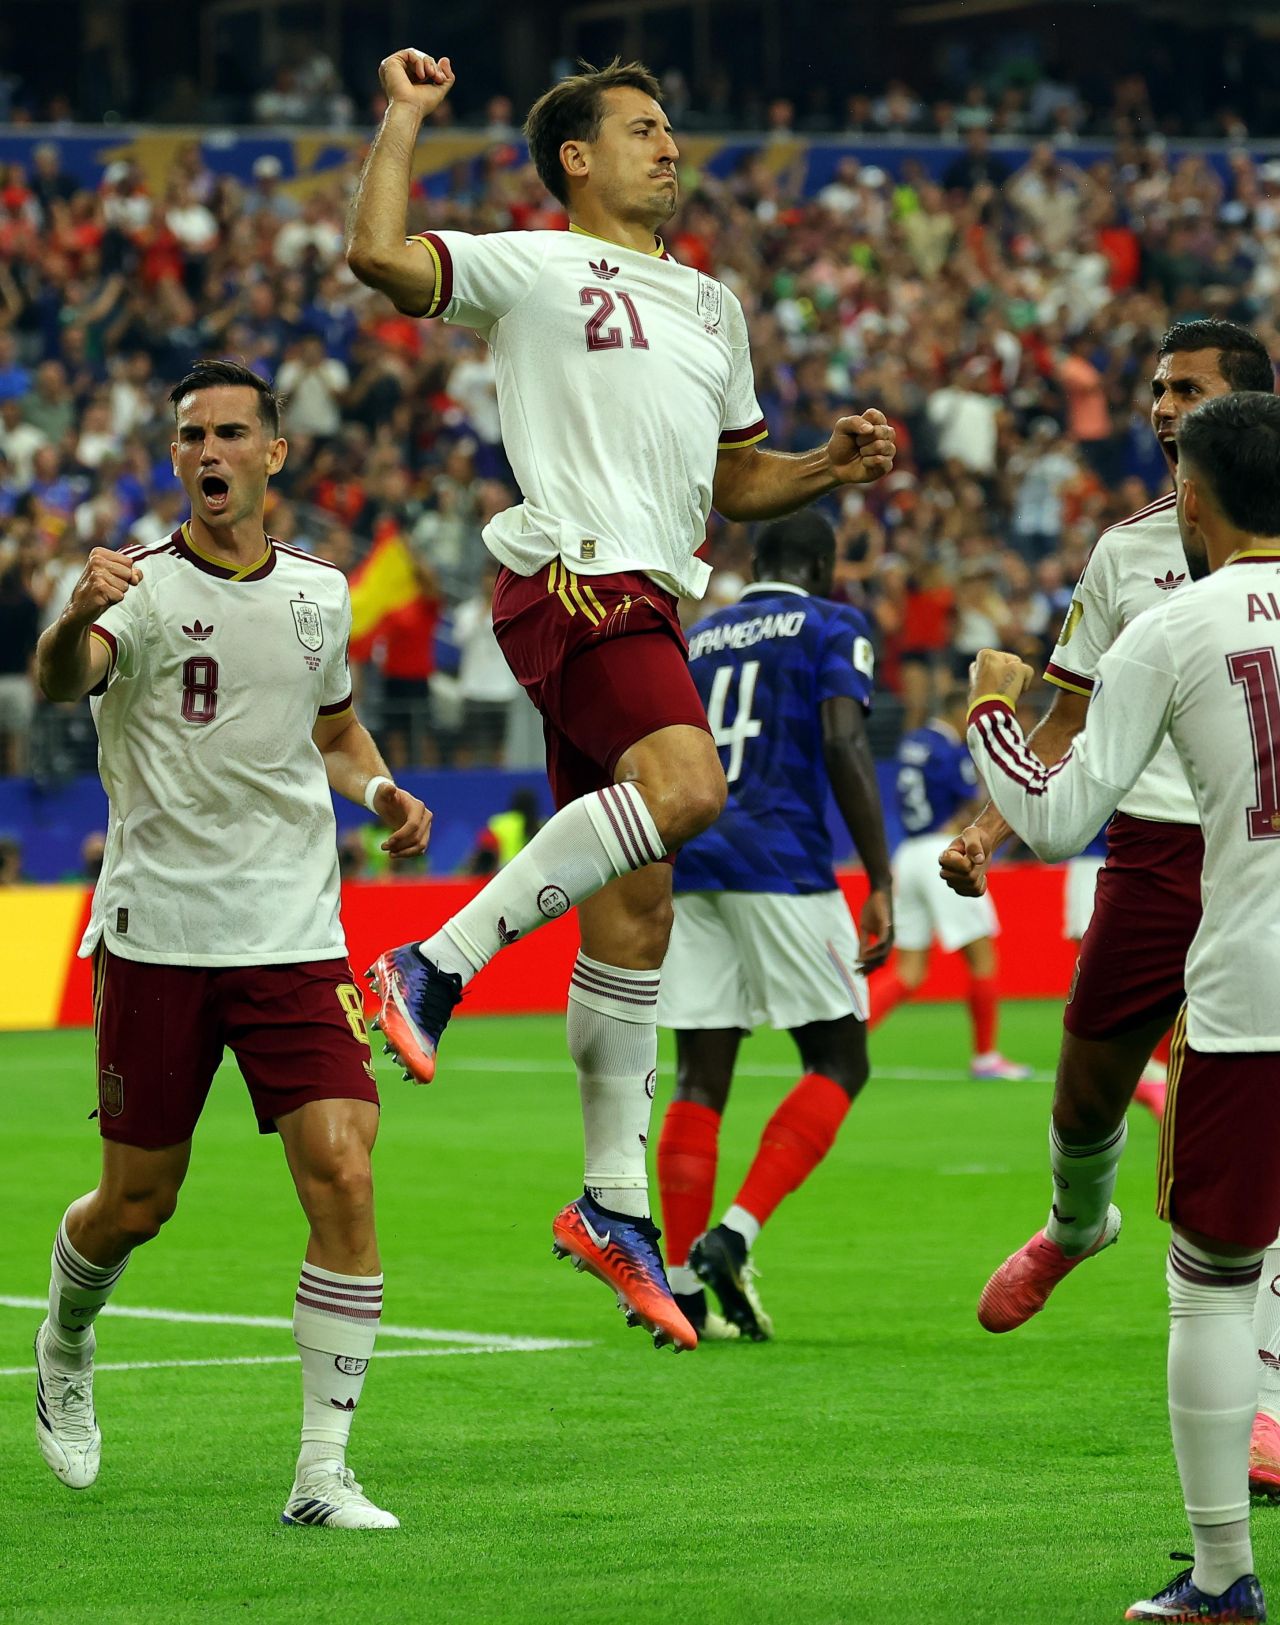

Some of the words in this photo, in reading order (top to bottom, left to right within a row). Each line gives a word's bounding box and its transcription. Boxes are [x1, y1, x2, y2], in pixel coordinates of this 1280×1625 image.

[578, 286, 650, 352] 21
[181, 656, 218, 724] 8
[707, 660, 763, 783] 4
[897, 766, 934, 832] 3
[335, 983, 370, 1046] 8
